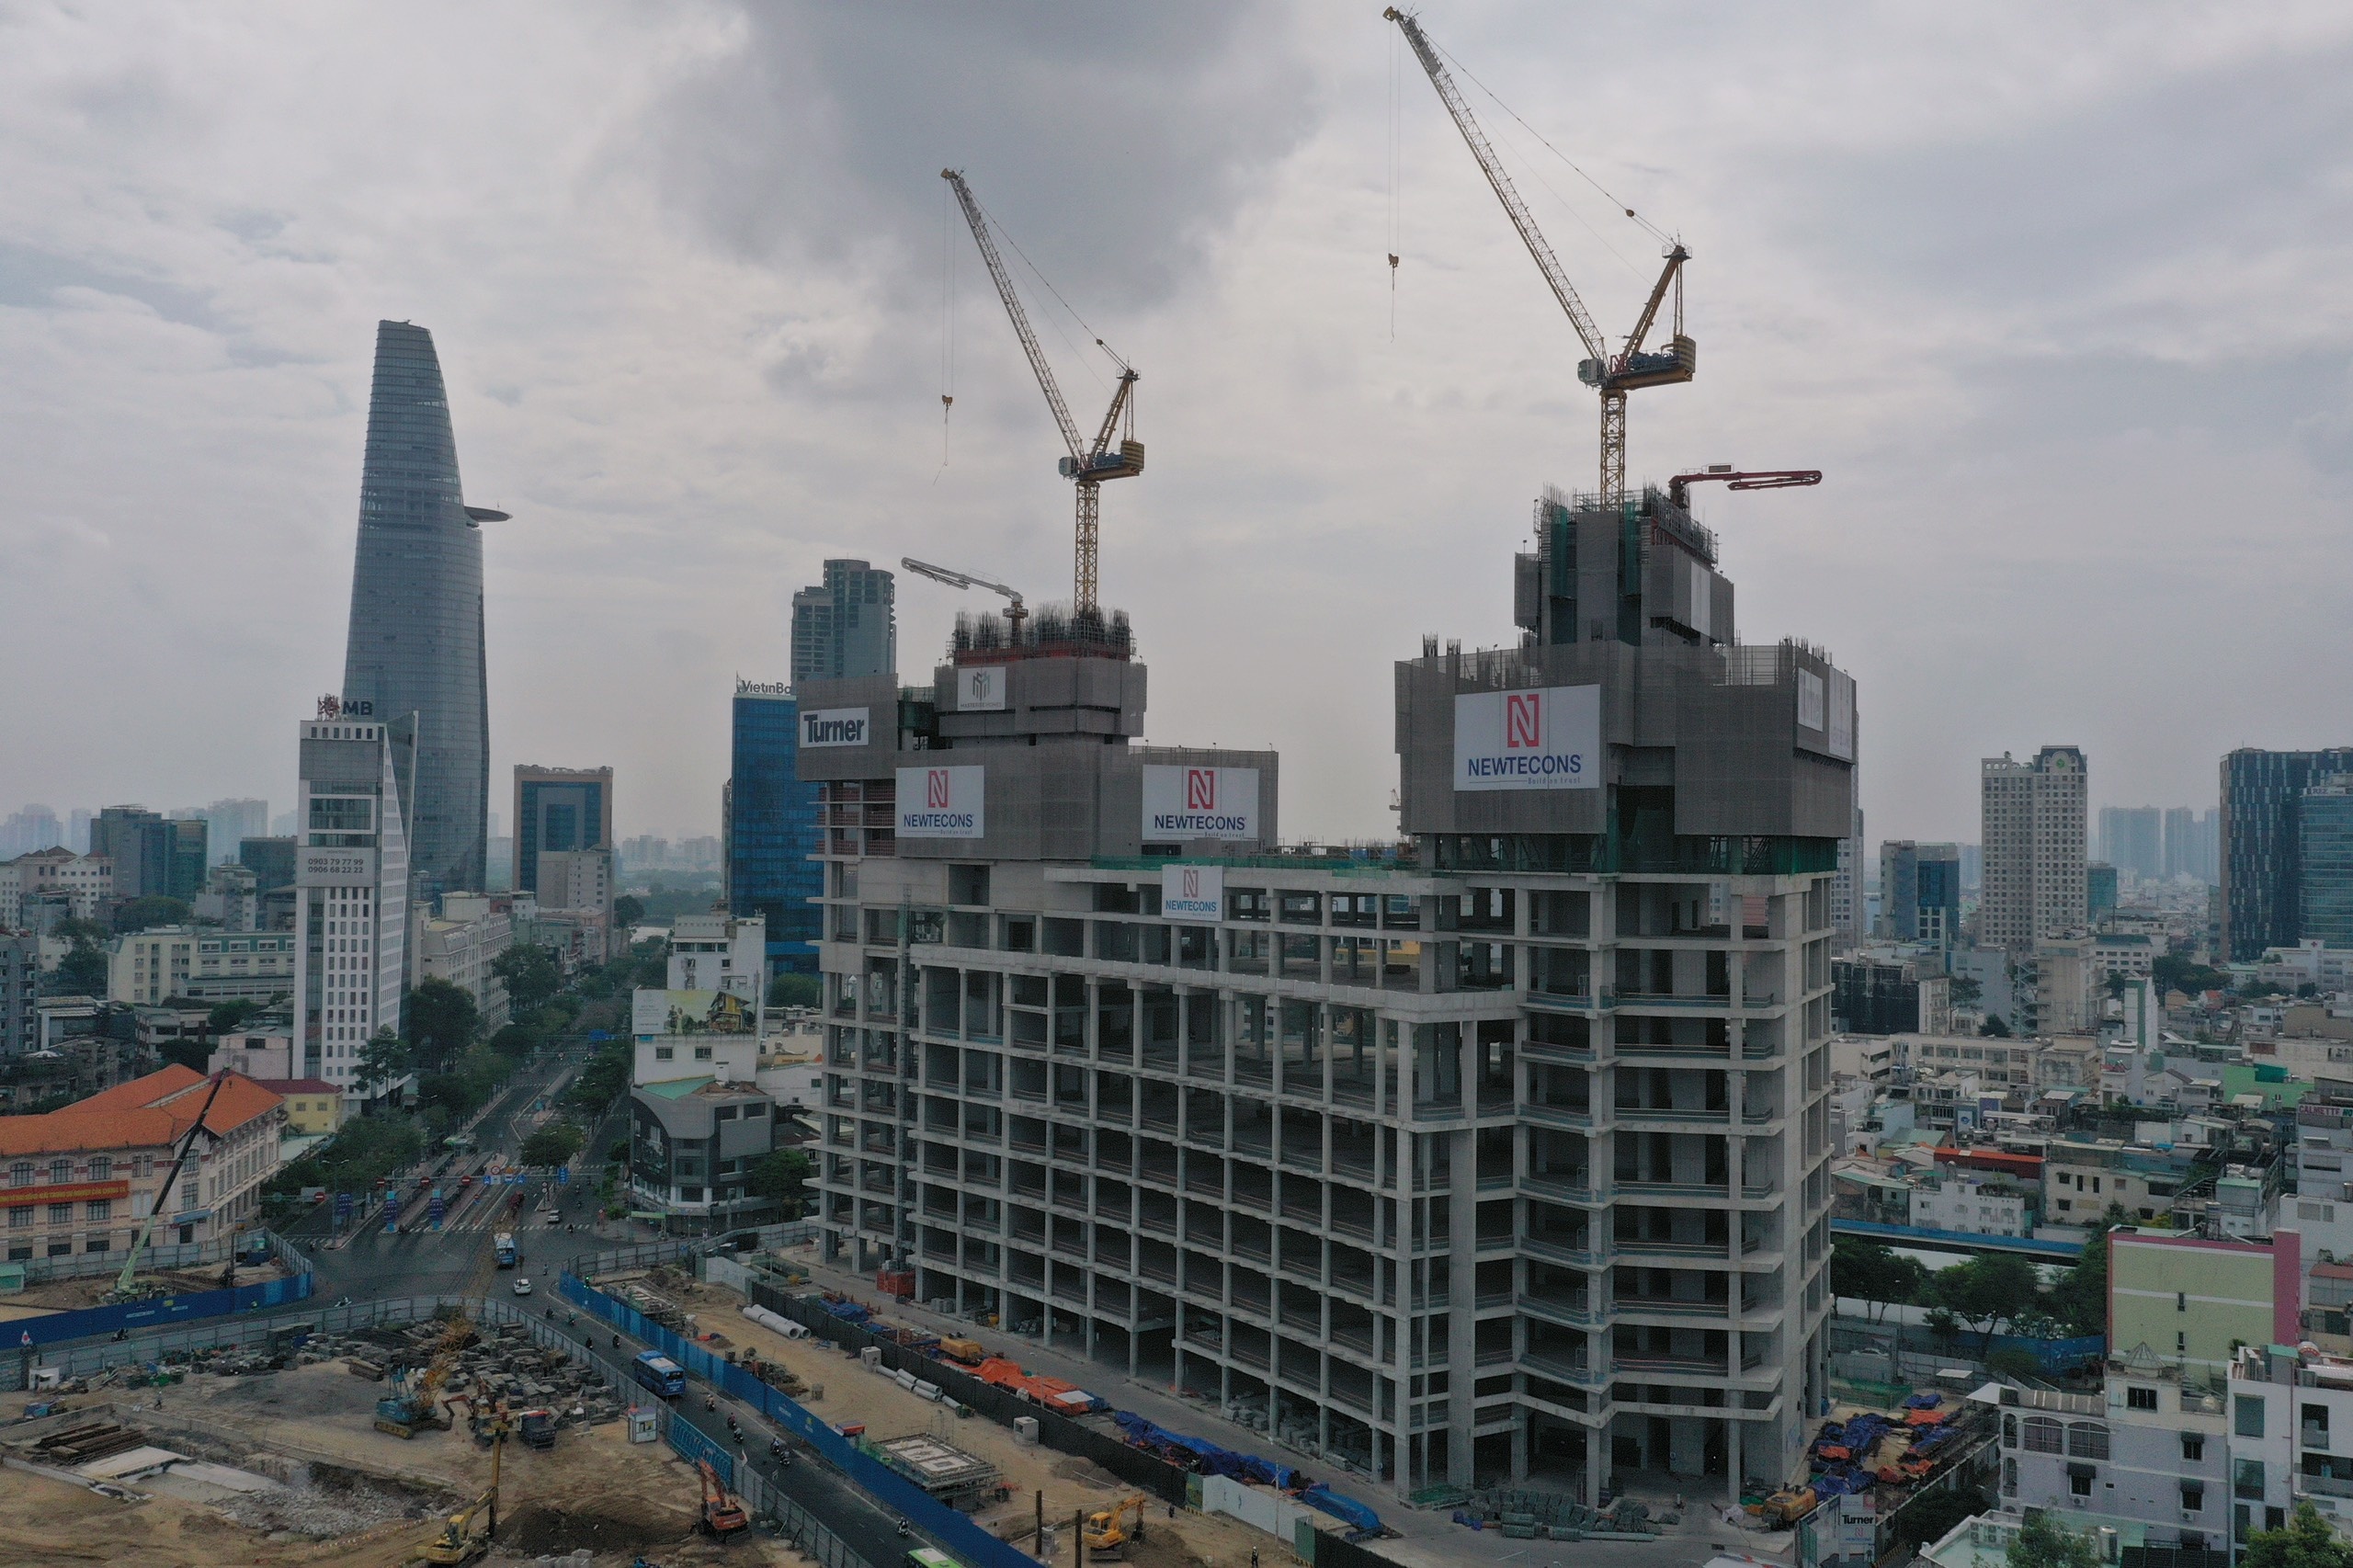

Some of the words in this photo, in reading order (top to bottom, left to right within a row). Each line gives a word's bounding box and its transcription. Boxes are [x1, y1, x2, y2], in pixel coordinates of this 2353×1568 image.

[343, 701, 372, 715] MB
[804, 714, 864, 743] Turner
[1468, 755, 1581, 776] NEWTECONS
[904, 813, 972, 828] NEWTECONS
[1154, 815, 1245, 830] NEWTECONS
[1165, 900, 1217, 912] NEWTECONS
[1842, 1515, 1874, 1525] Turner
